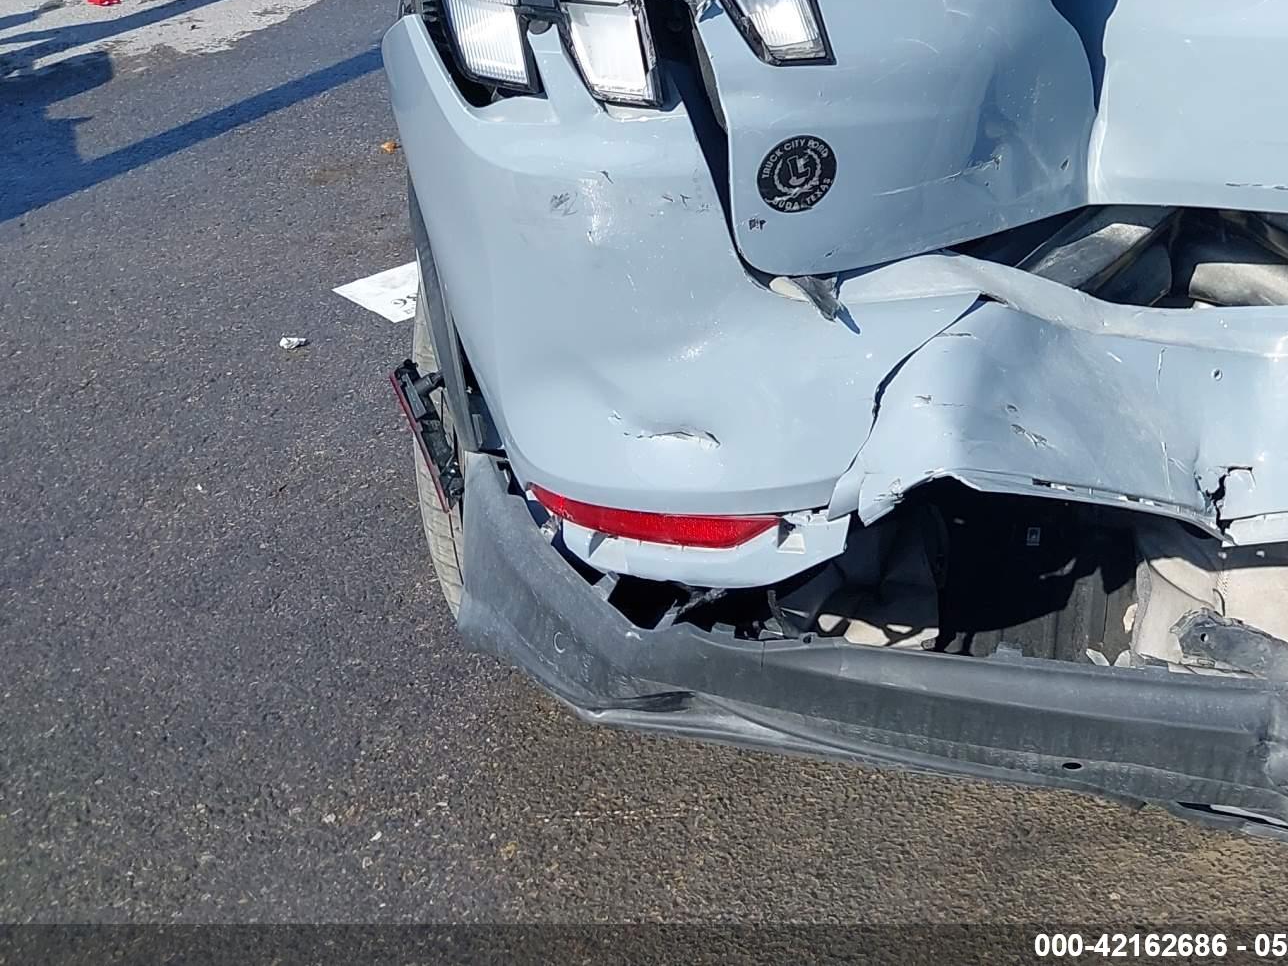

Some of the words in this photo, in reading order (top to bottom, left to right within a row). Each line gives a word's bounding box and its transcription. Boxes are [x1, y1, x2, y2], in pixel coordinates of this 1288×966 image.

[762, 149, 784, 178] TRUCK
[784, 139, 806, 151] CITY
[806, 178, 831, 204] TEXAS
